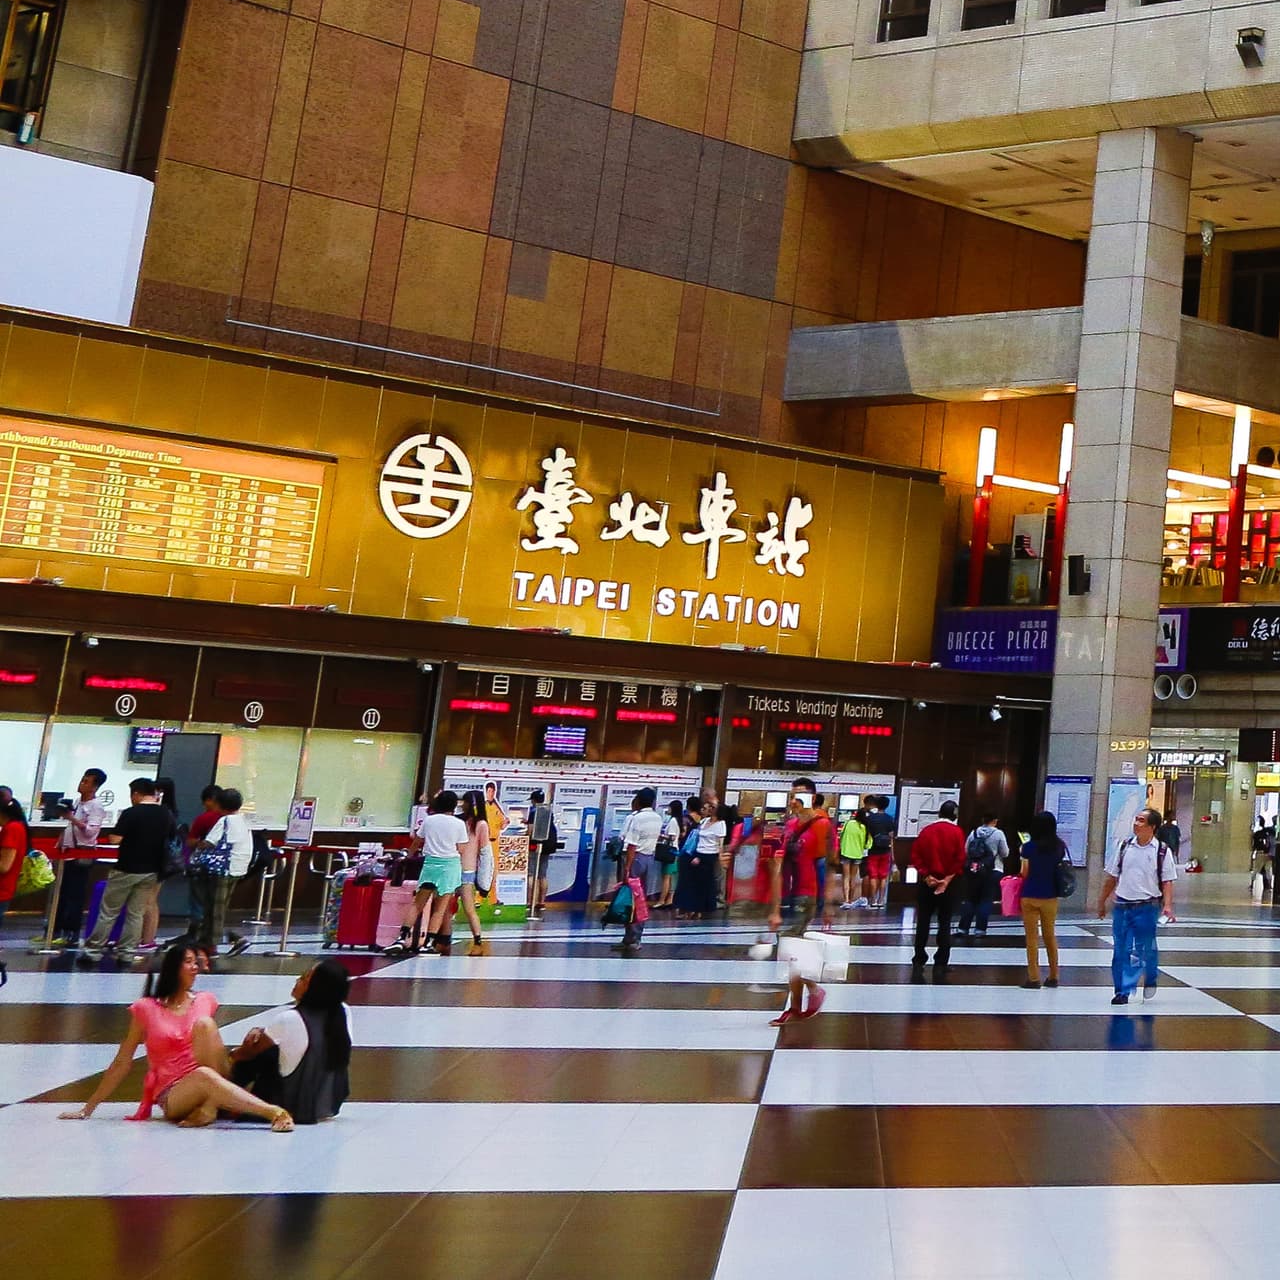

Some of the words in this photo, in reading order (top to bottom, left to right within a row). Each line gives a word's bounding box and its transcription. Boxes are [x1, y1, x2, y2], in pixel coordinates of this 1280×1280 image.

[0, 431, 104, 453] rthbound/Eastbound
[106, 444, 154, 461] Departure
[157, 451, 182, 465] Time
[516, 447, 814, 580] 臺北車站
[513, 571, 631, 611] TAIPEI
[655, 587, 801, 629] STATION
[947, 631, 996, 650] BREEZE
[1007, 630, 1049, 650] PLAZA
[491, 674, 679, 708] 自動售票機
[748, 695, 790, 713] Tickets
[796, 699, 838, 718] Vending
[843, 702, 884, 720] Machine
